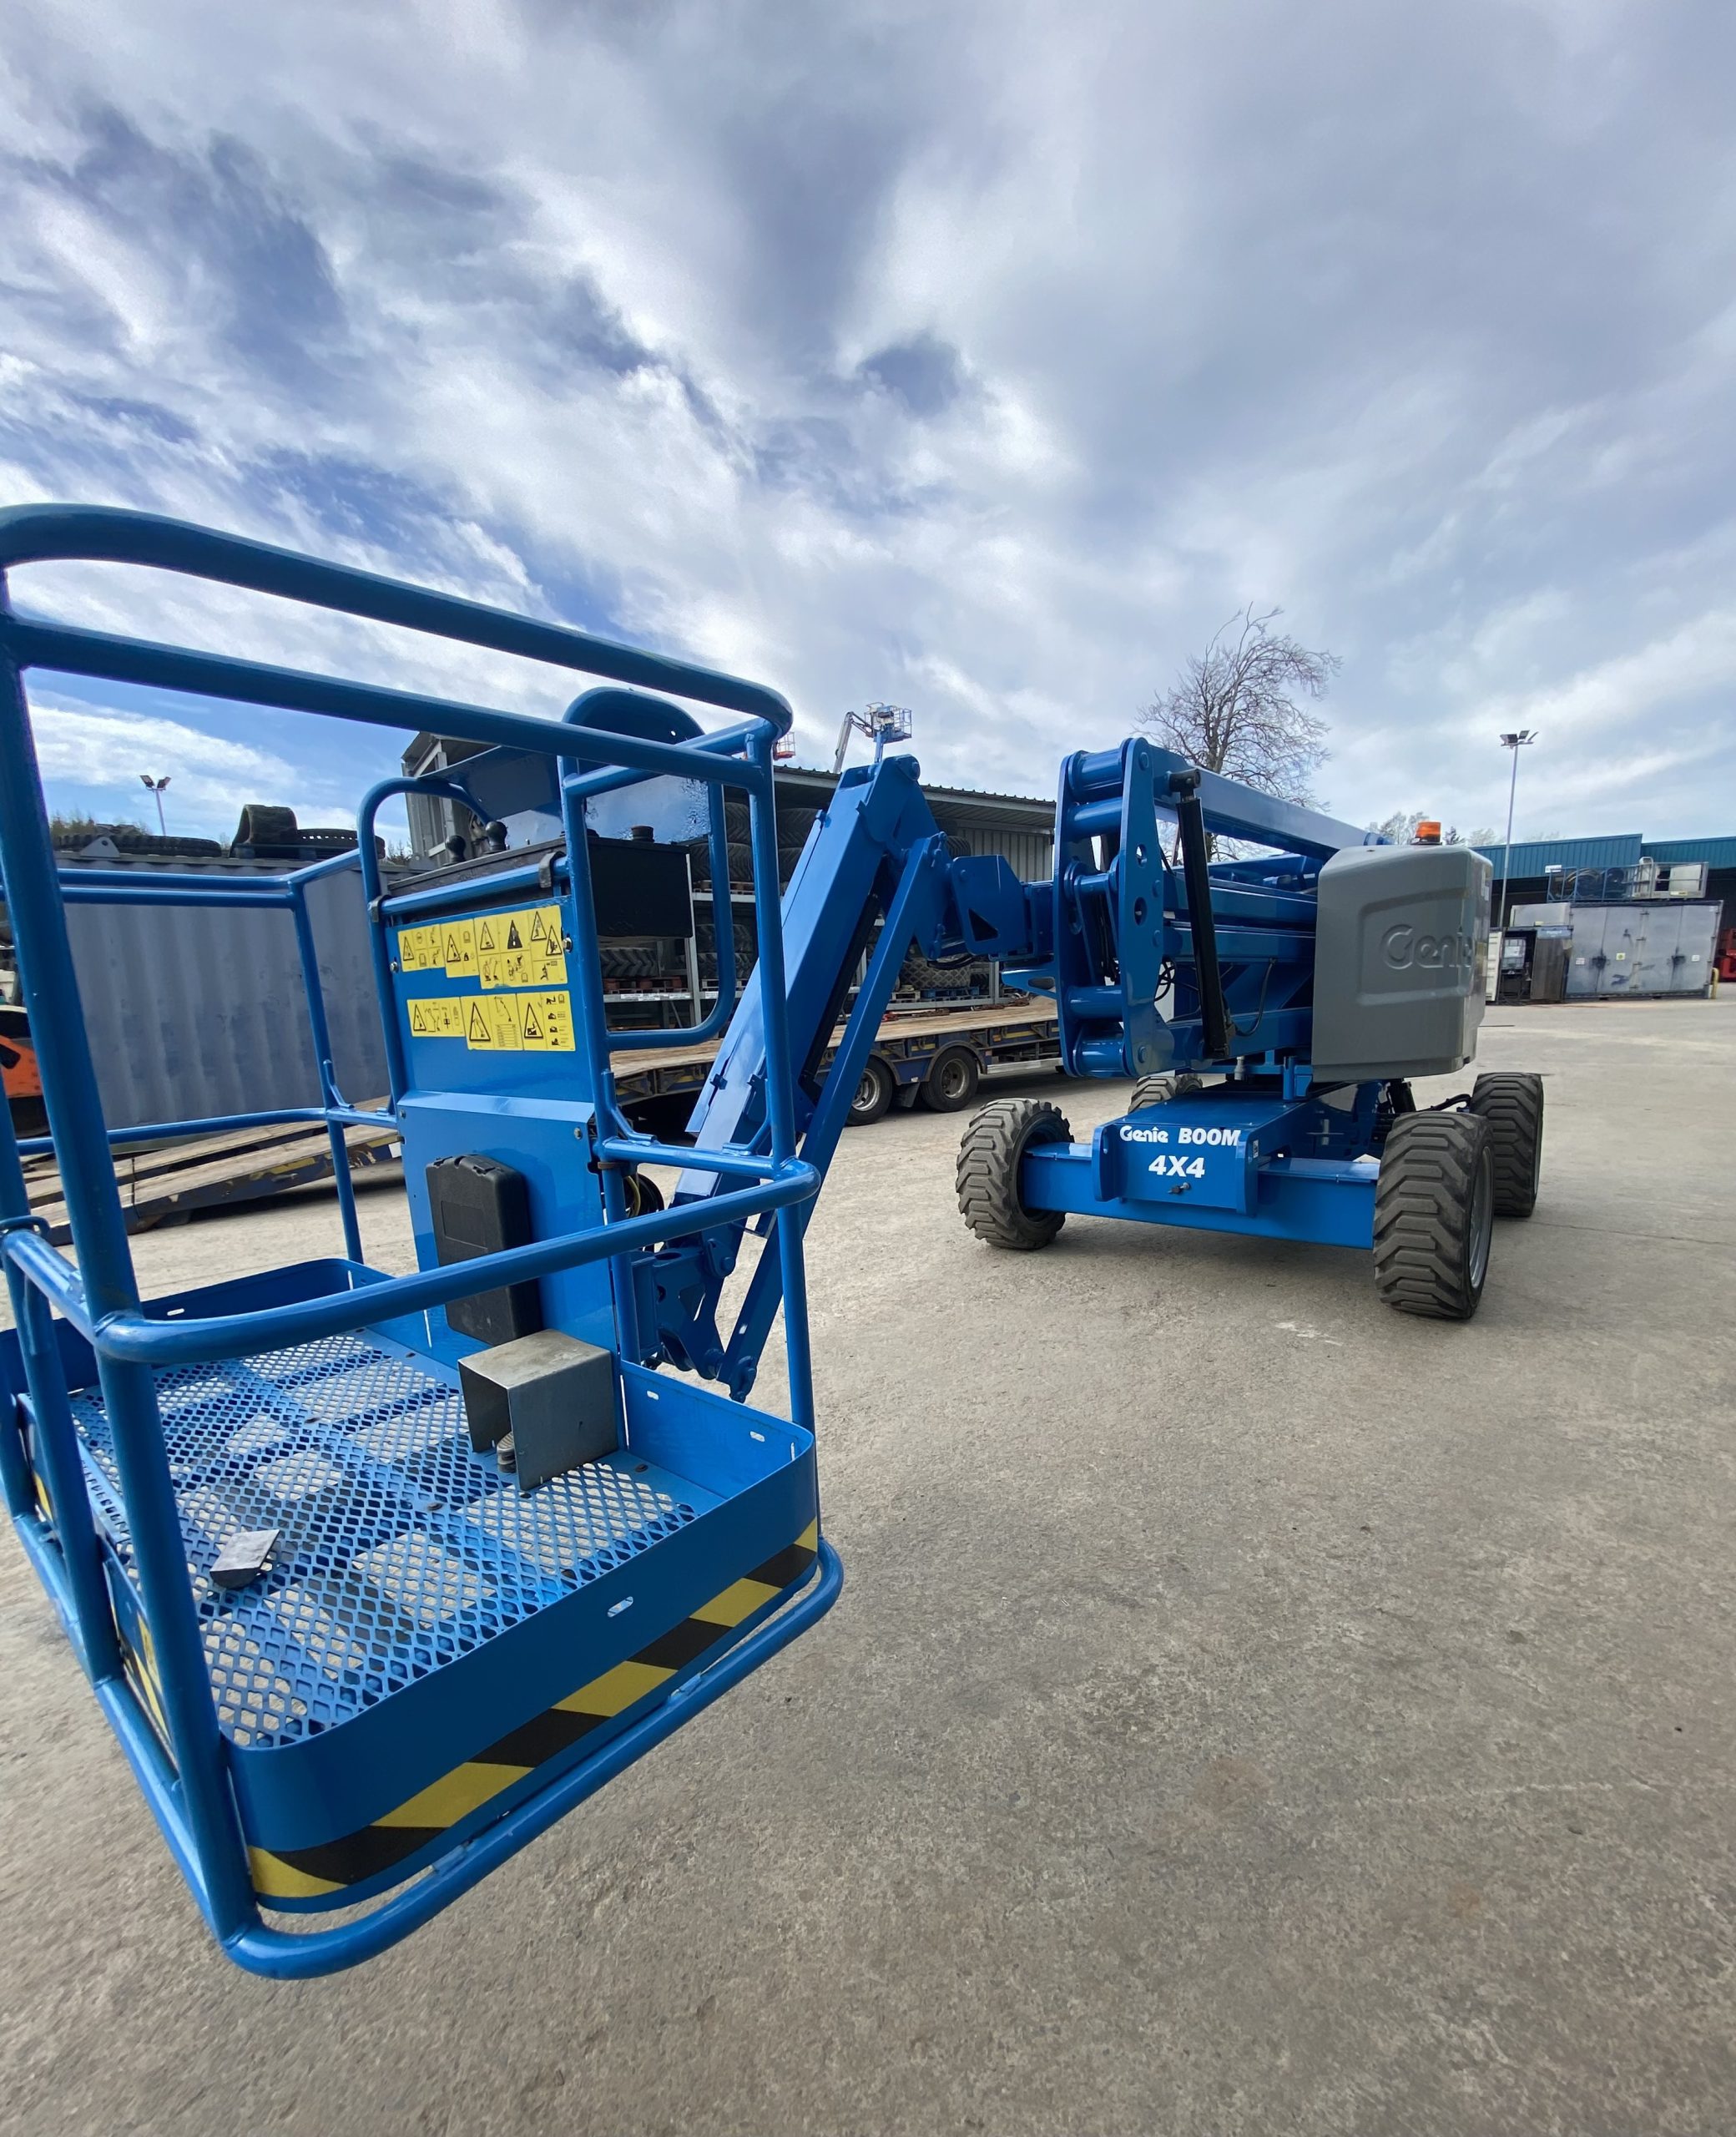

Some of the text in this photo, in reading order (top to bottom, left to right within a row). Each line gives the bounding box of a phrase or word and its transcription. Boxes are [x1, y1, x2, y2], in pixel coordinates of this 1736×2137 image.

[1119, 1125, 1242, 1147] Genie BOOM
[1148, 1154, 1206, 1179] 4X4
